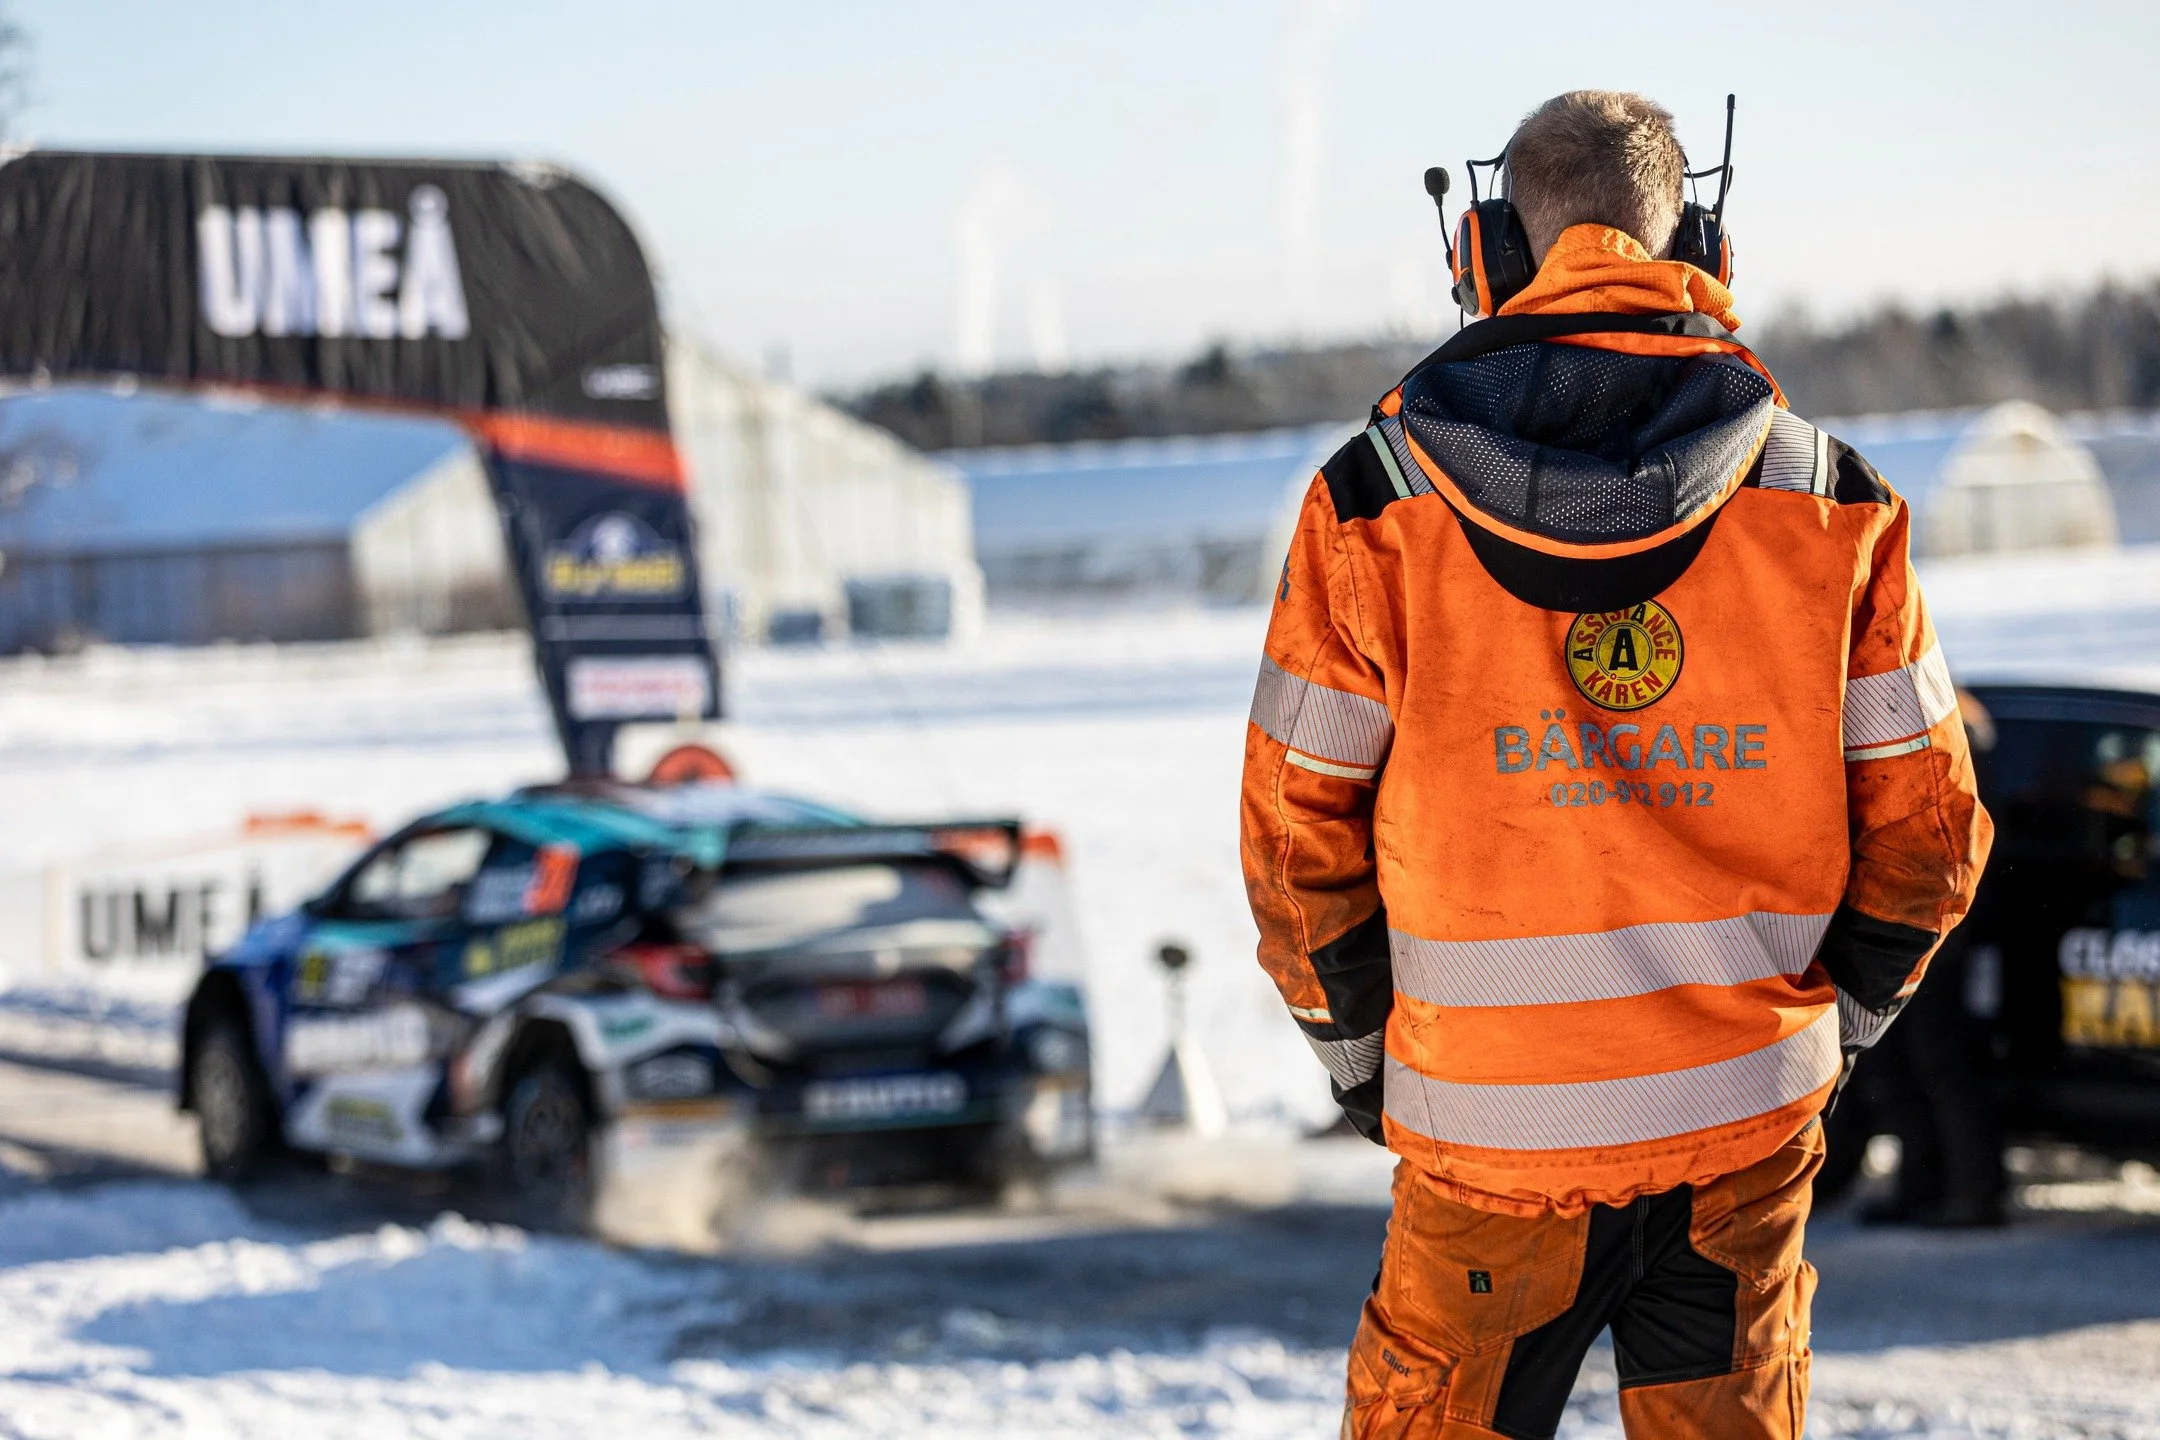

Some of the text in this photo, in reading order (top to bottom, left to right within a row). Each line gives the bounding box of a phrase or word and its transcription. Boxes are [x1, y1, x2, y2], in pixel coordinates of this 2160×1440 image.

[199, 187, 468, 338] UMEÅ
[1582, 669, 1665, 705] KÅREN
[1494, 708, 1767, 774] BÄRGARE
[1658, 781, 1714, 807] 912
[1382, 1348, 1410, 1378] Elliot
